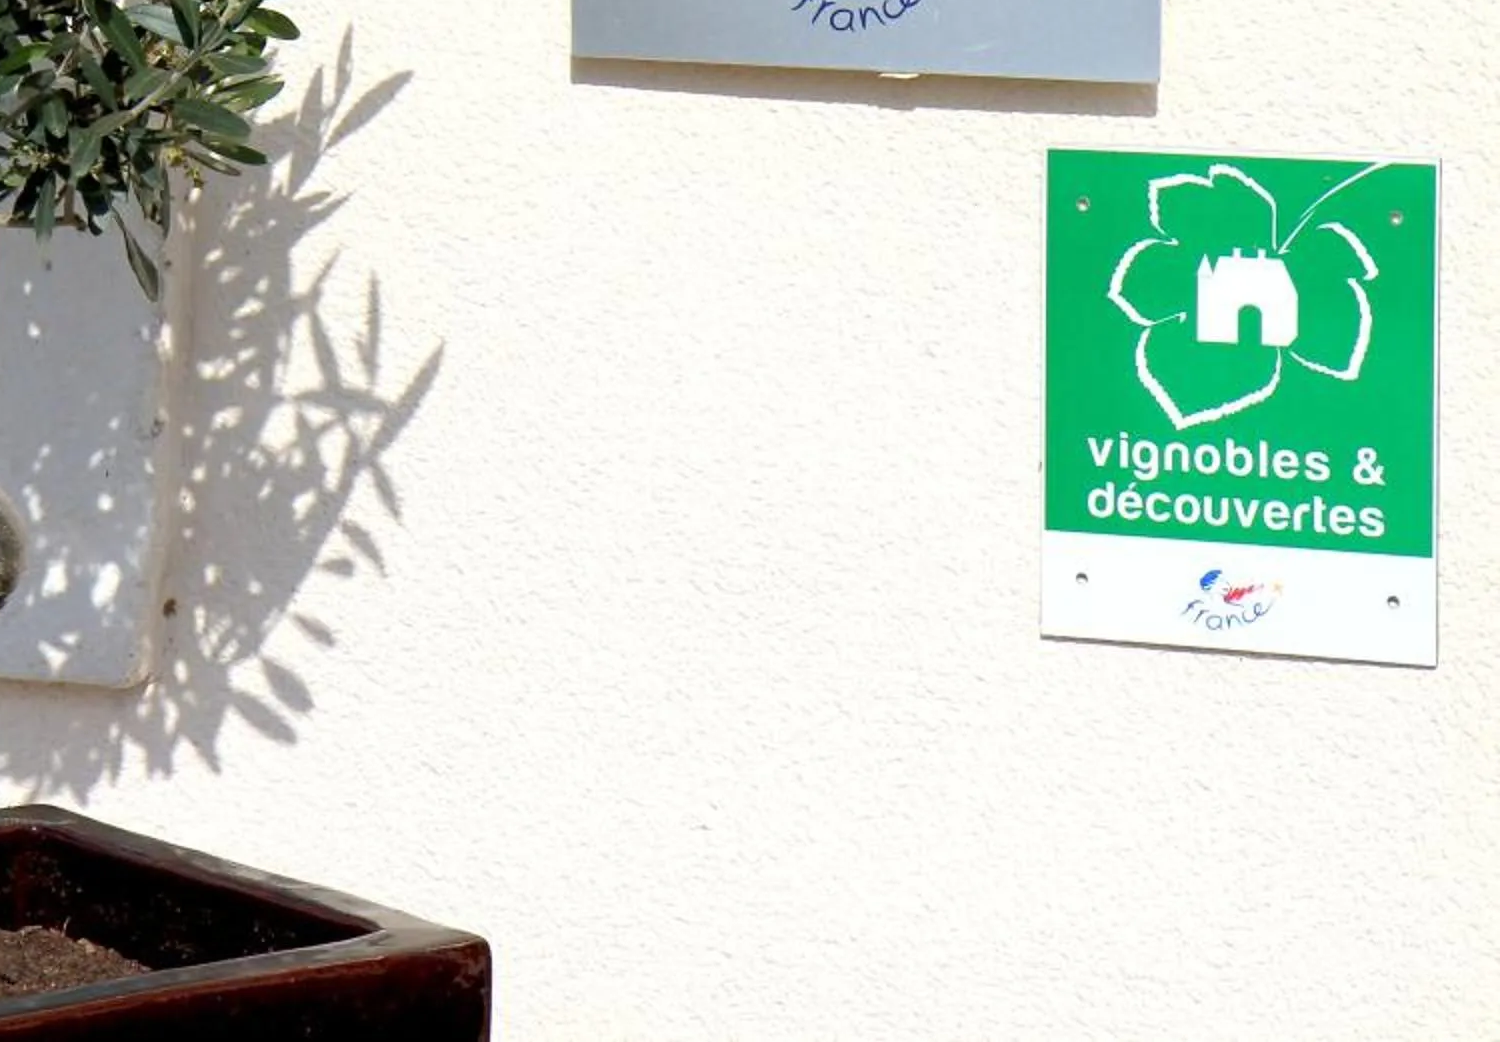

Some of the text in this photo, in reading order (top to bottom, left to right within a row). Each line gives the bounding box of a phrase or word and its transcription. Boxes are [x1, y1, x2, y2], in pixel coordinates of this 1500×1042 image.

[1087, 432, 1386, 487] vignobles &
[1087, 482, 1386, 538] découvertes
